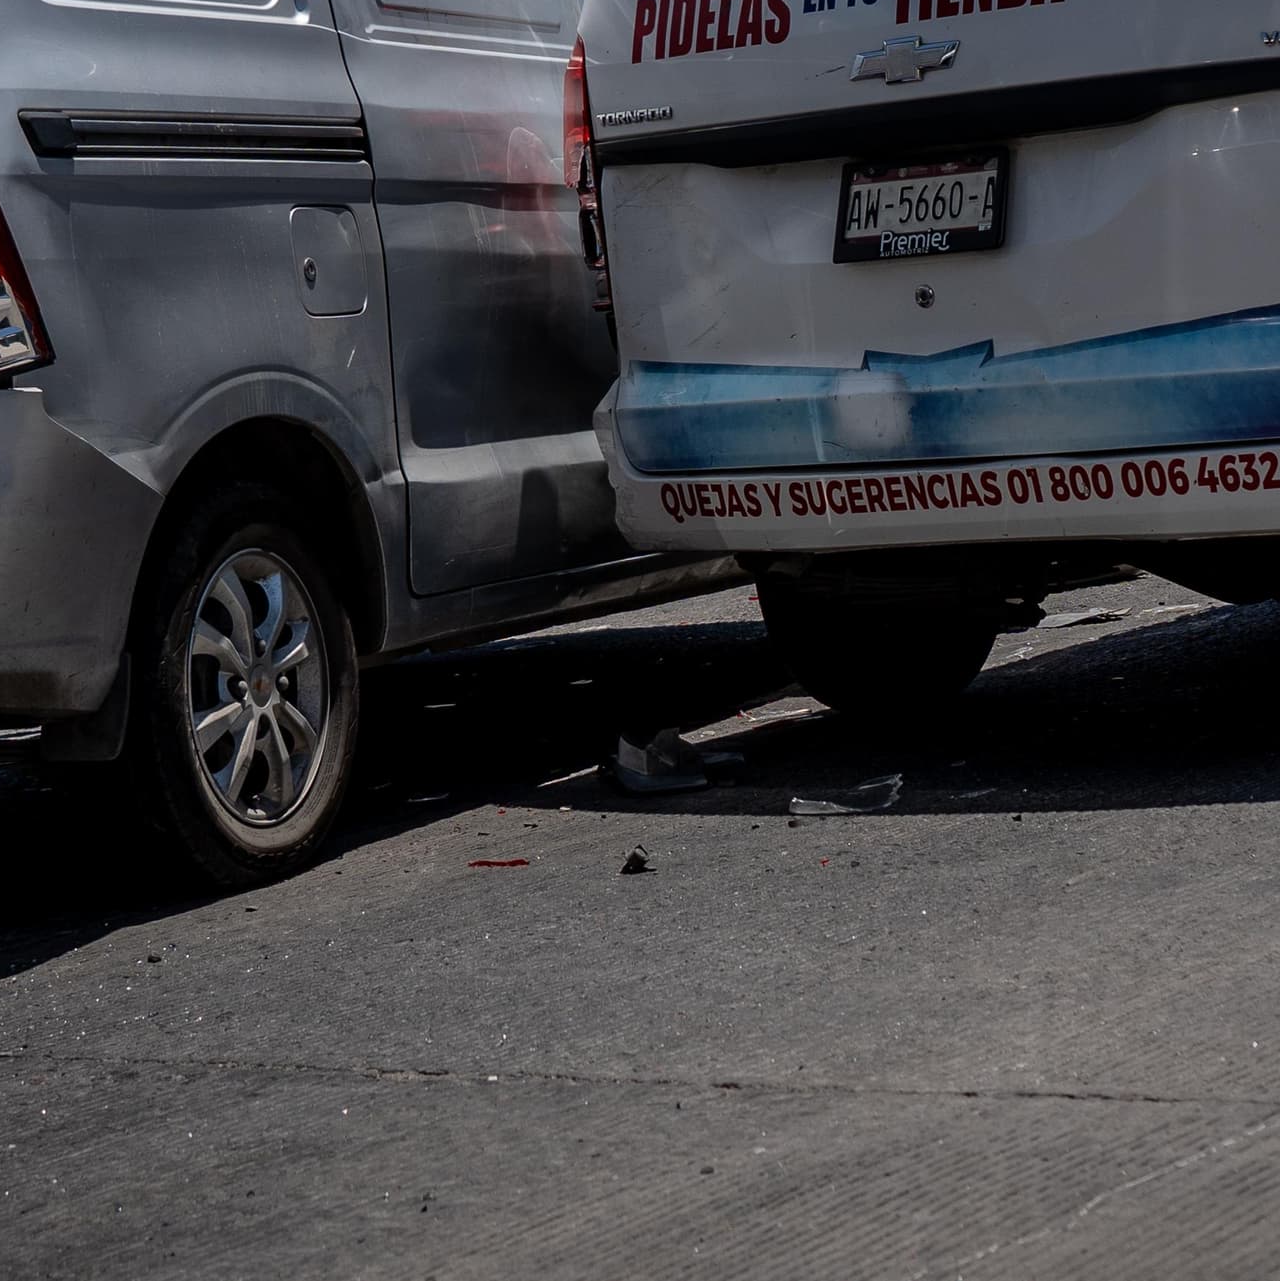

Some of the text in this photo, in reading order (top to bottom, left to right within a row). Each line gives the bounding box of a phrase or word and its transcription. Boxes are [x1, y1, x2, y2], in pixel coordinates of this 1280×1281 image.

[596, 106, 673, 127] TORNADO
[848, 177, 994, 230] AW-5660-A
[880, 228, 951, 252] Premier
[661, 483, 762, 522] QUEJAS
[763, 483, 781, 517] Y
[789, 471, 1002, 516] SUGERENCIAS
[1007, 468, 1043, 504] 01
[1049, 464, 1114, 501] 800
[1121, 458, 1189, 497] 006
